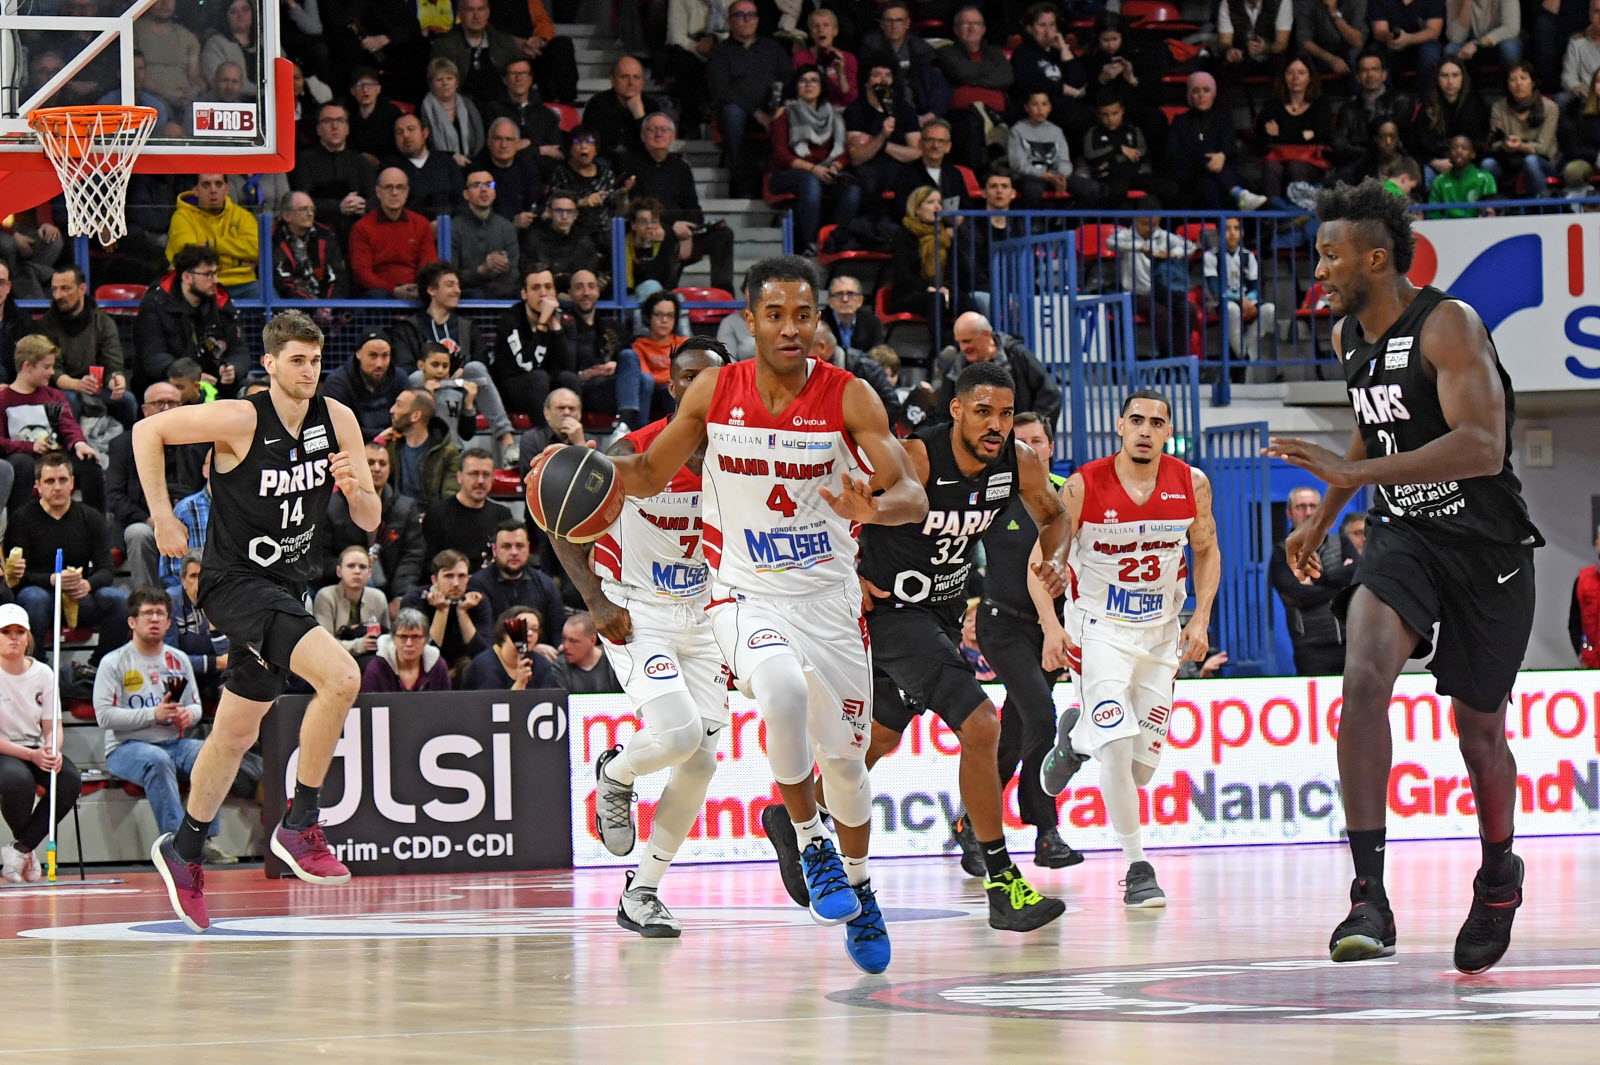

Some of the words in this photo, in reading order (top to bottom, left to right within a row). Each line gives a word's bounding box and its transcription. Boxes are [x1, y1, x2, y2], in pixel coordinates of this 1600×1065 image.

[718, 433, 762, 445] ATALIAN
[258, 458, 329, 497] PARIS
[717, 453, 770, 477] GRAND
[774, 457, 836, 480] NANCY
[279, 496, 305, 529] 14
[647, 496, 689, 505] ATALIAN
[766, 484, 798, 517] 4
[679, 535, 700, 559] 7
[743, 528, 833, 563] MOSER
[930, 535, 969, 566] 32
[1118, 554, 1161, 582] 23
[1105, 583, 1164, 615] MOSER
[1093, 706, 1122, 723] cora
[284, 702, 513, 827] dlsi
